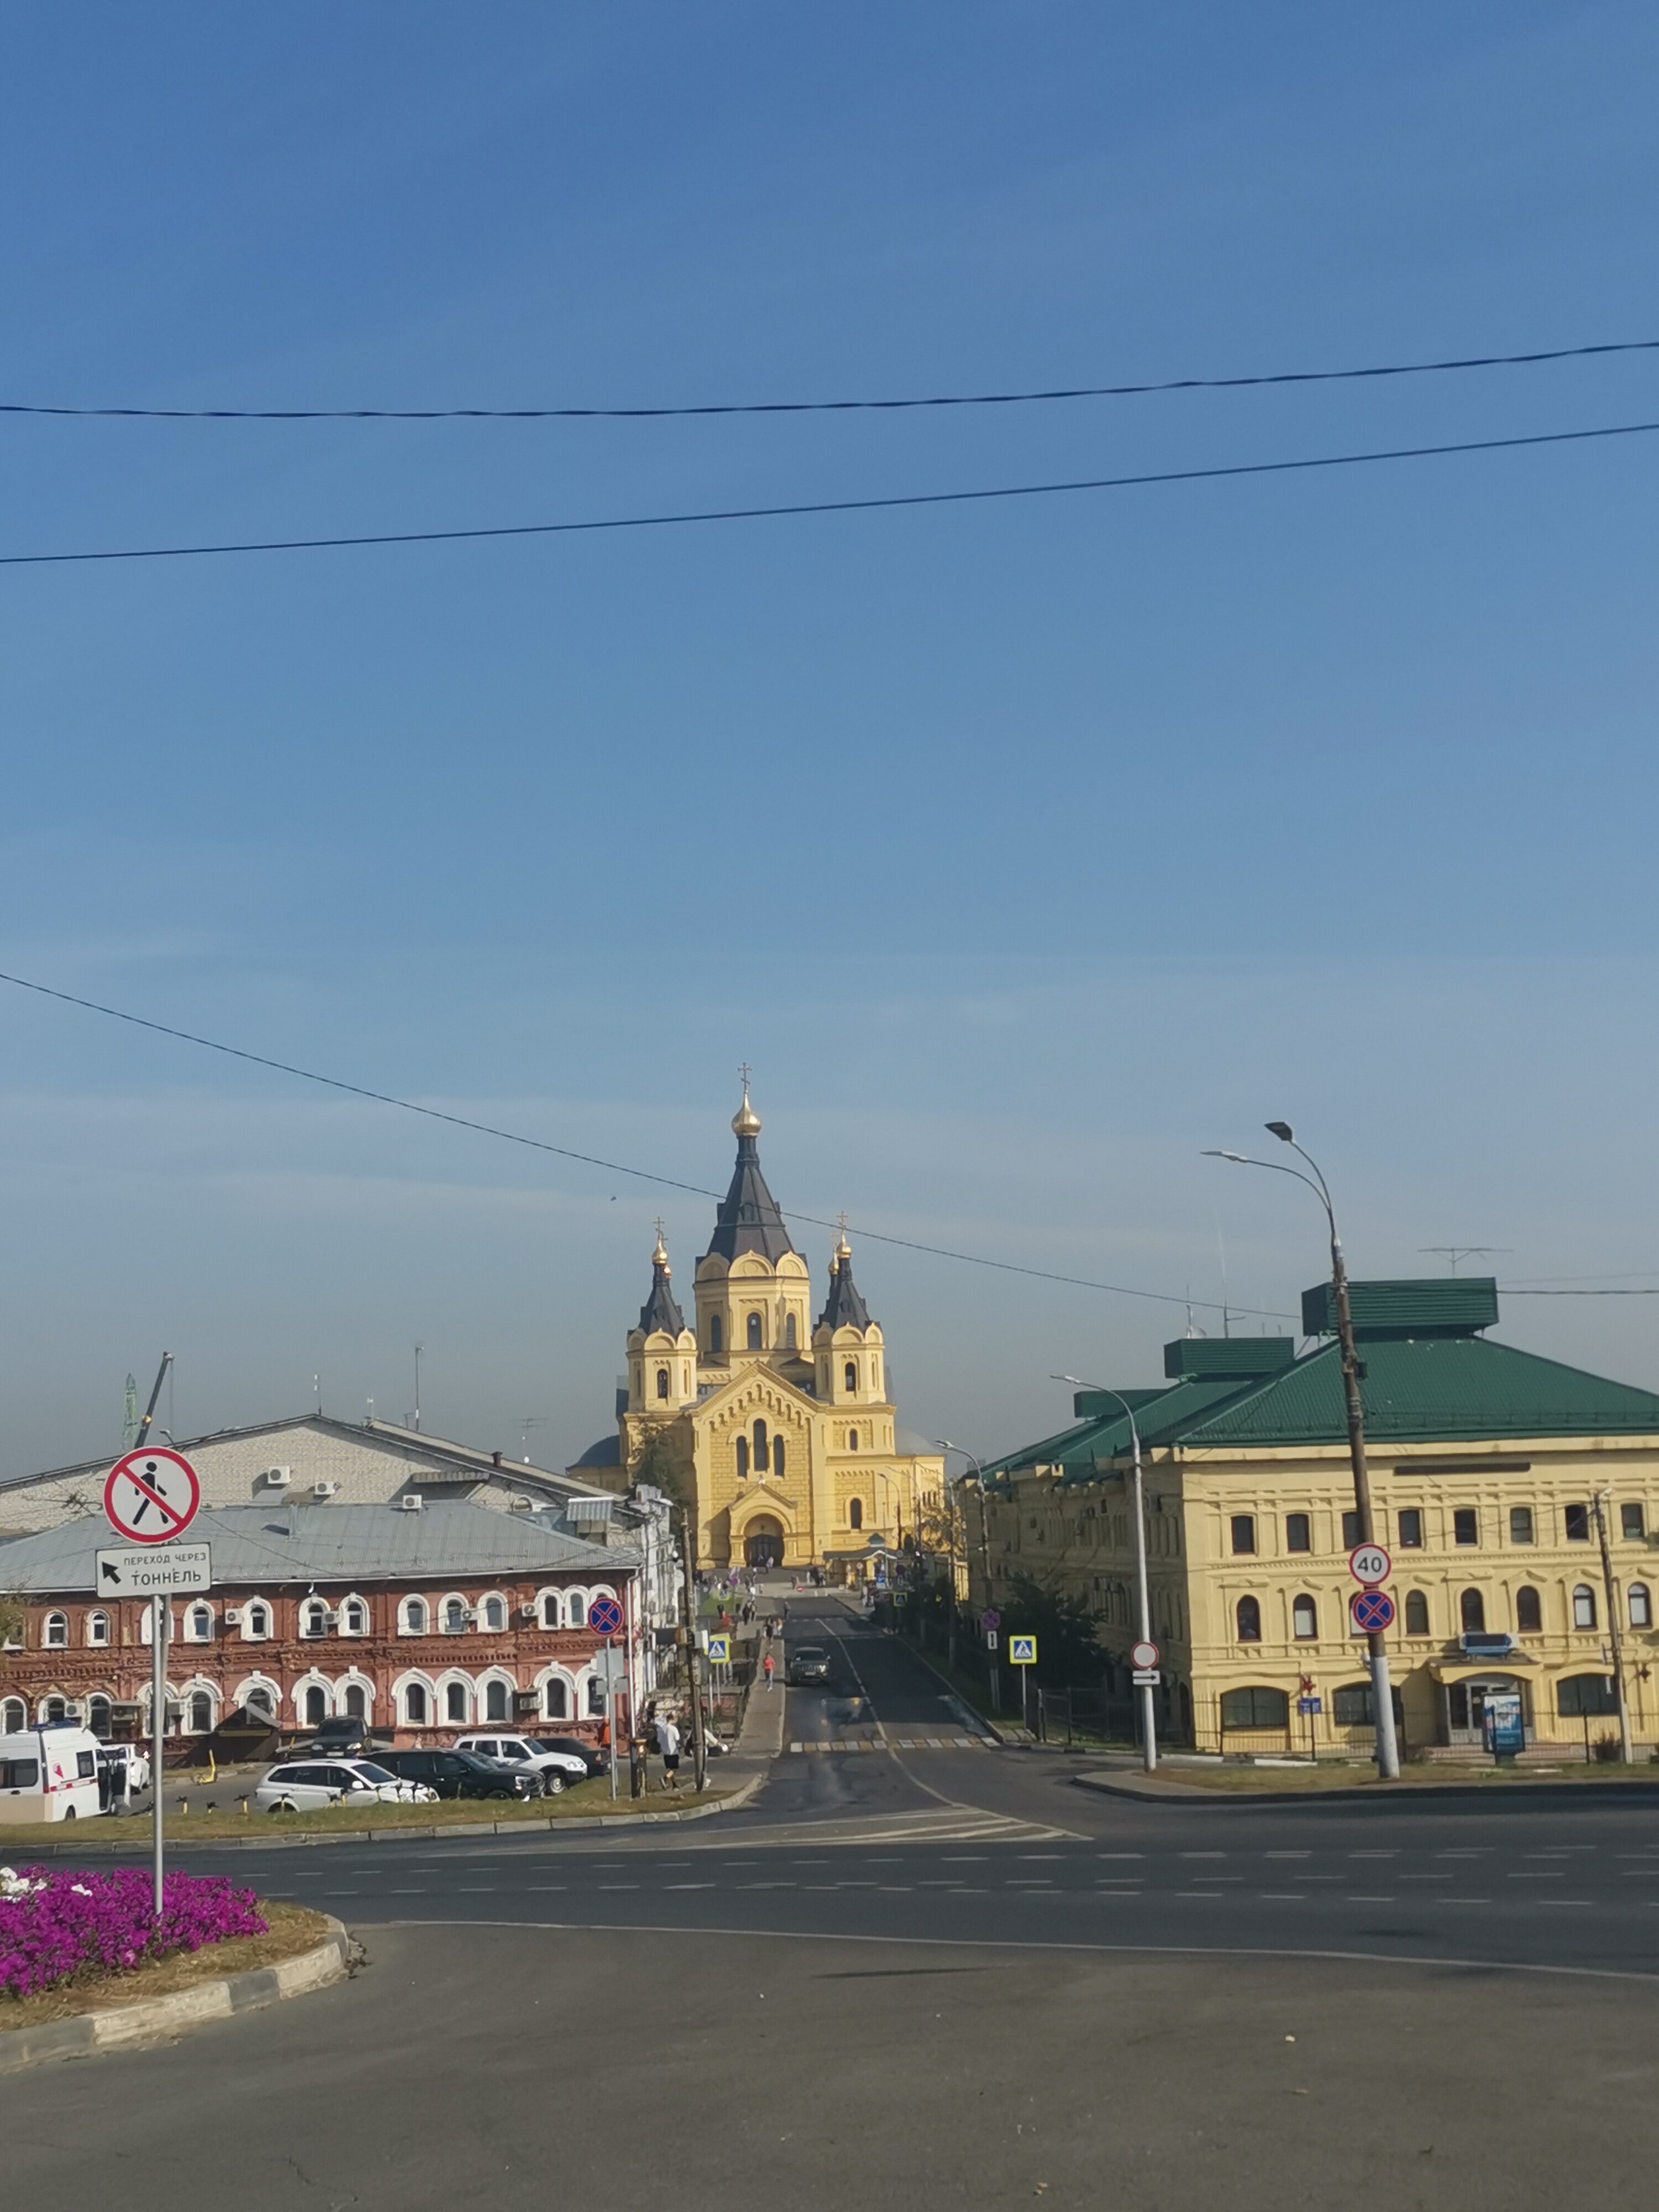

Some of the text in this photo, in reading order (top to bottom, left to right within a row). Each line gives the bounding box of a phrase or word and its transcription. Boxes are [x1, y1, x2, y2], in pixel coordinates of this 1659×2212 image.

[123, 1552, 206, 1566] ПЕРЕХОД ЧЕРЕЗ
[1357, 1556, 1382, 1573] 40
[131, 1570, 201, 1586] ТОННЕЛЬ
